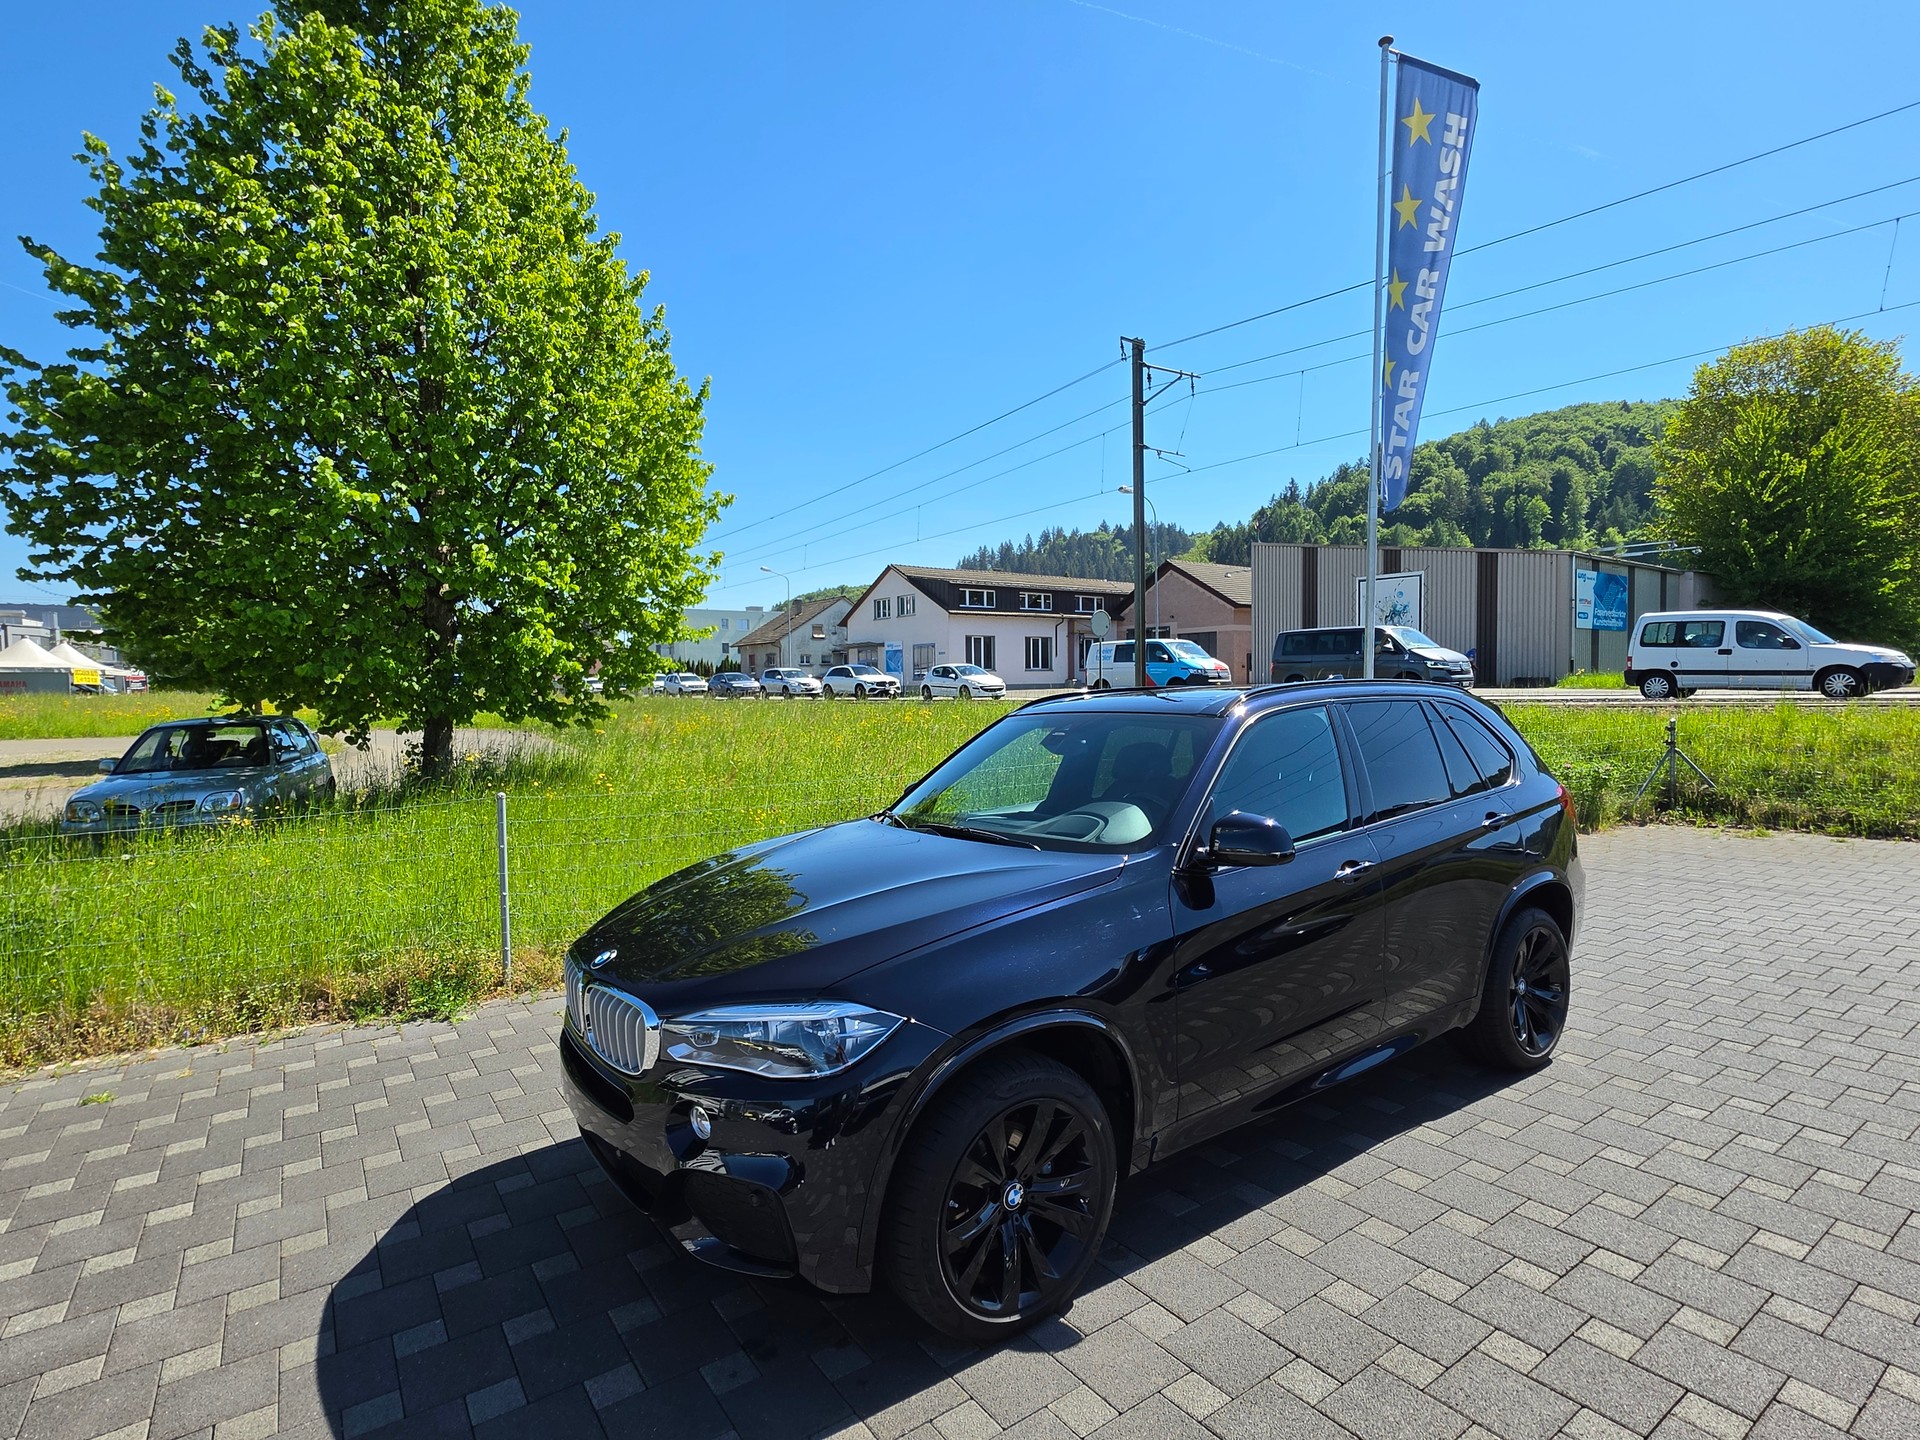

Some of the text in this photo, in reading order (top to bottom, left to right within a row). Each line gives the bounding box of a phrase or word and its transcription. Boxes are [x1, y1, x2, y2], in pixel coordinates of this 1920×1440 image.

[1387, 111, 1468, 480] STAR CAR WASH
